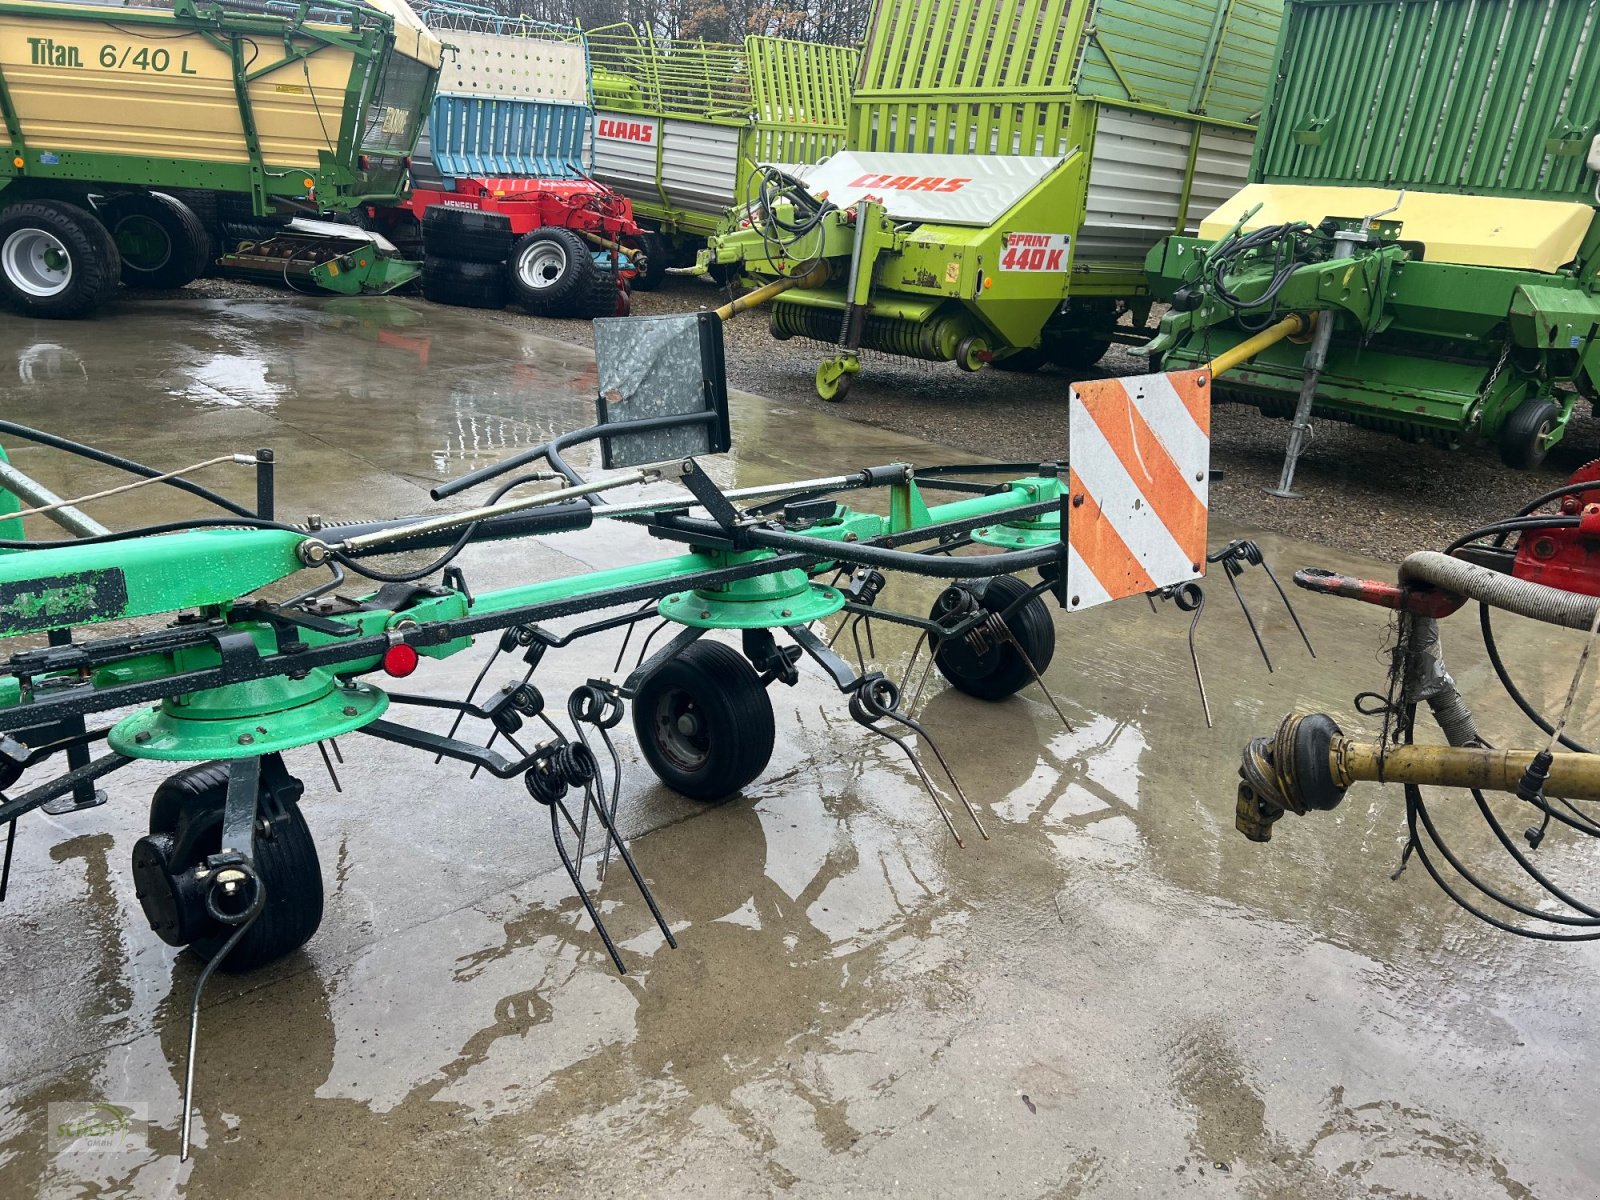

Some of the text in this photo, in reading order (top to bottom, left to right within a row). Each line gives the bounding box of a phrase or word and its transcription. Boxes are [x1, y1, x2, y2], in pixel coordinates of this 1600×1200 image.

[27, 37, 197, 74] Titan 6/40 L
[598, 119, 653, 142] CLAAS
[847, 174, 973, 192] CLAAS
[1007, 234, 1051, 247] SPRINT
[1002, 247, 1064, 270] 440 K
